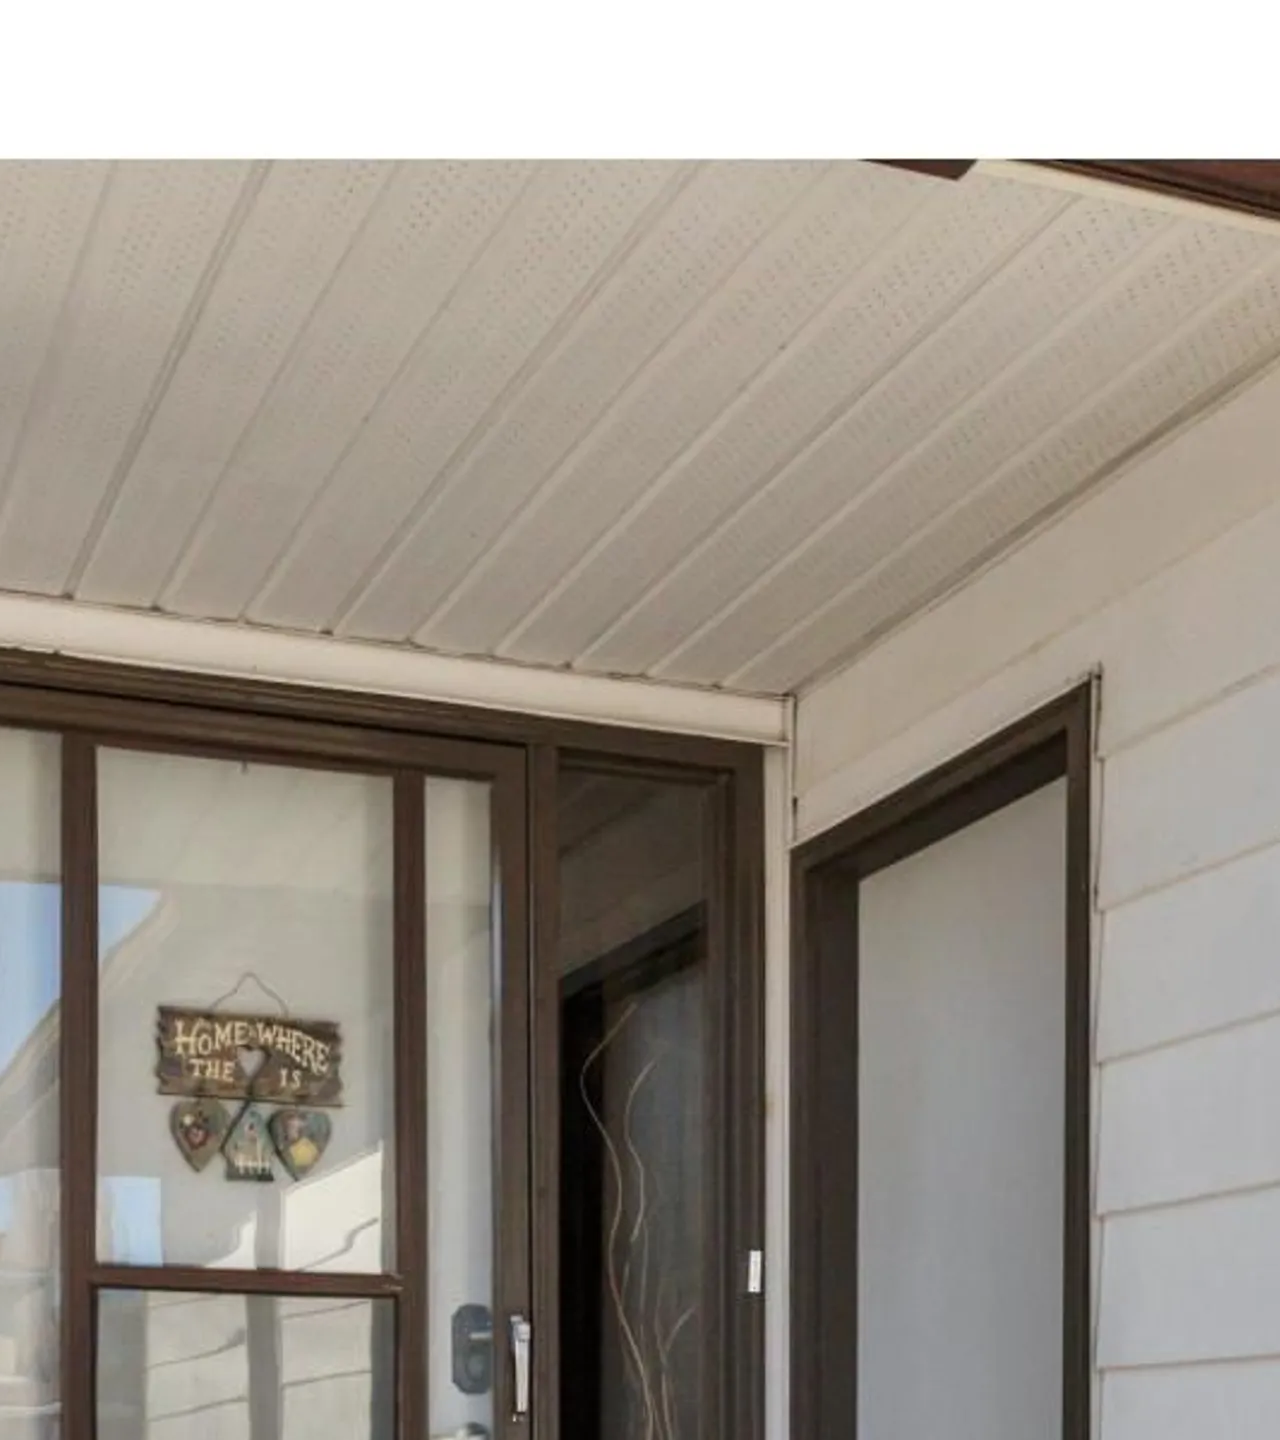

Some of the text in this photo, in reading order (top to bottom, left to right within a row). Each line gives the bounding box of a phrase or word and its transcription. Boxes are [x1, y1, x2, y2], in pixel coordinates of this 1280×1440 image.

[174, 1016, 332, 1076] HOME WHERE
[188, 1057, 302, 1089] THE IS
